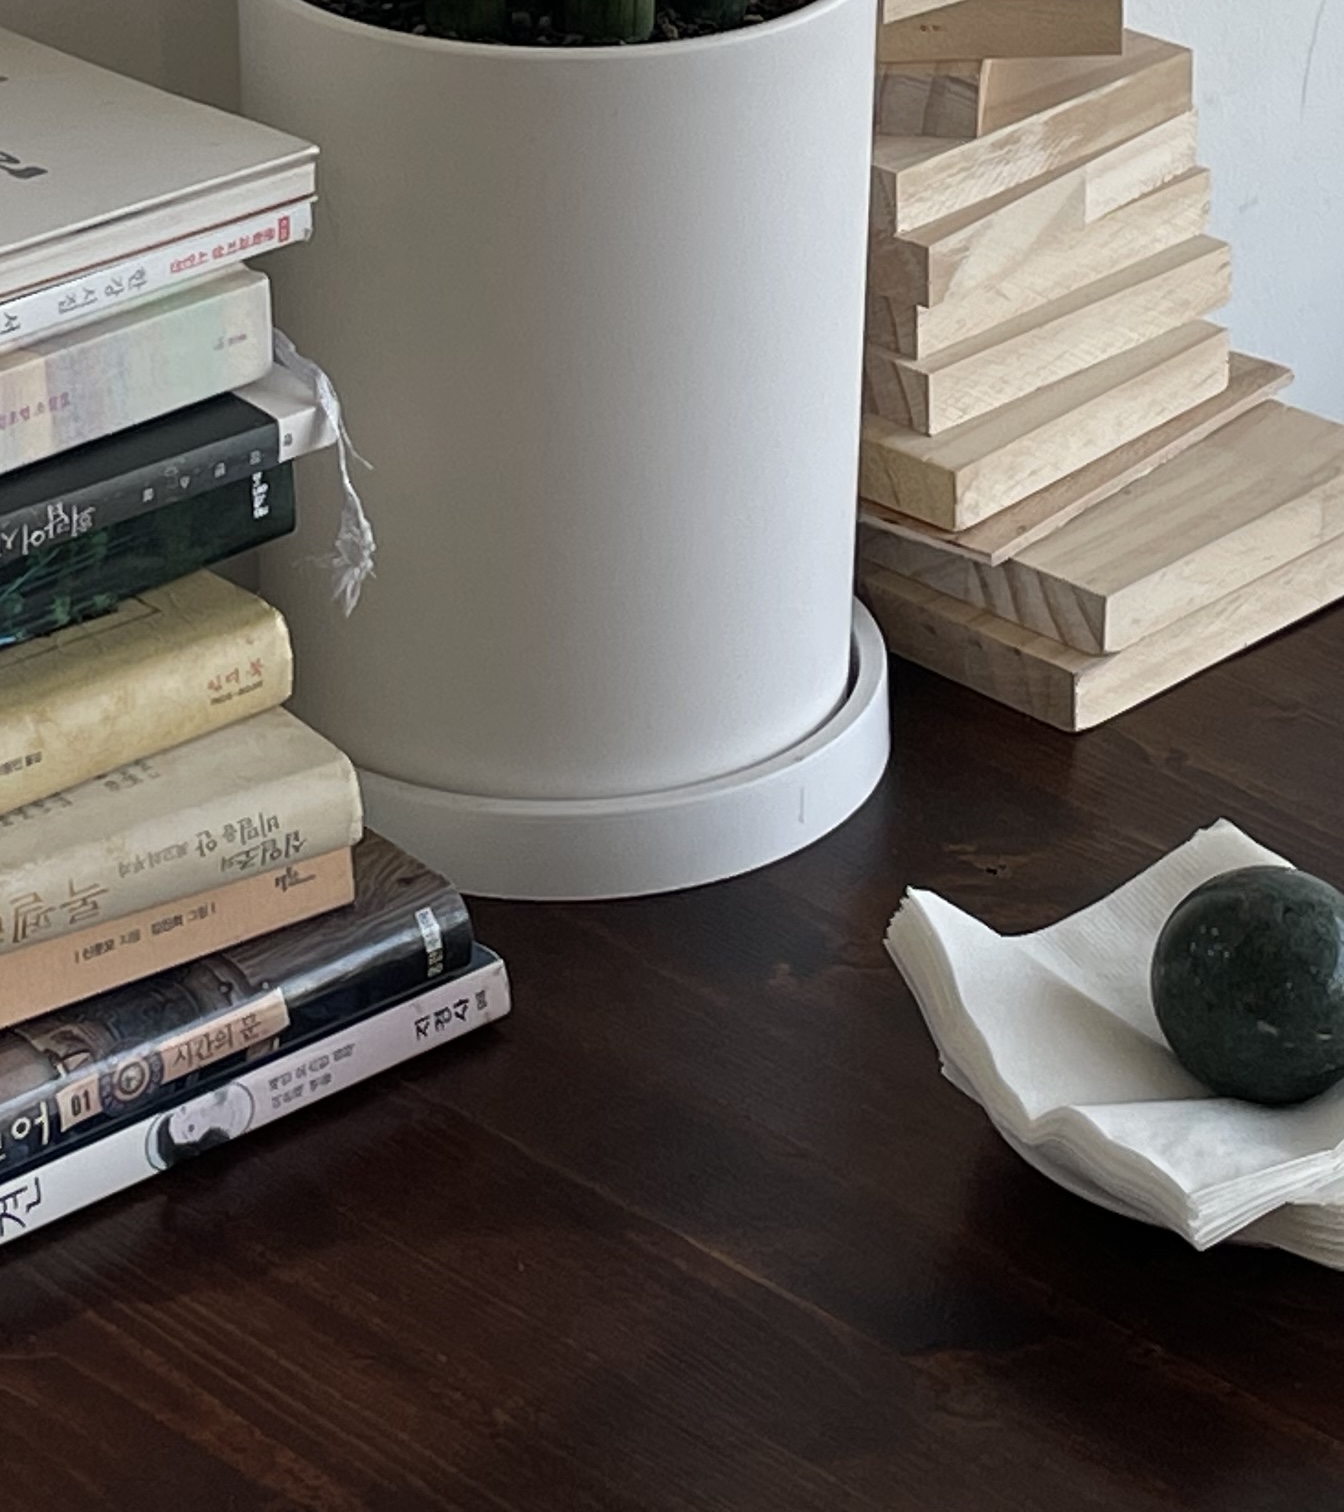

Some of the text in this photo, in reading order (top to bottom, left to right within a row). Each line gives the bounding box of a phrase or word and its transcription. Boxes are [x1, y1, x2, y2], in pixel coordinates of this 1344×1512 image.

[172, 1023, 235, 1071] 시간의
[239, 1014, 264, 1043] 문
[70, 1090, 92, 1118] 01
